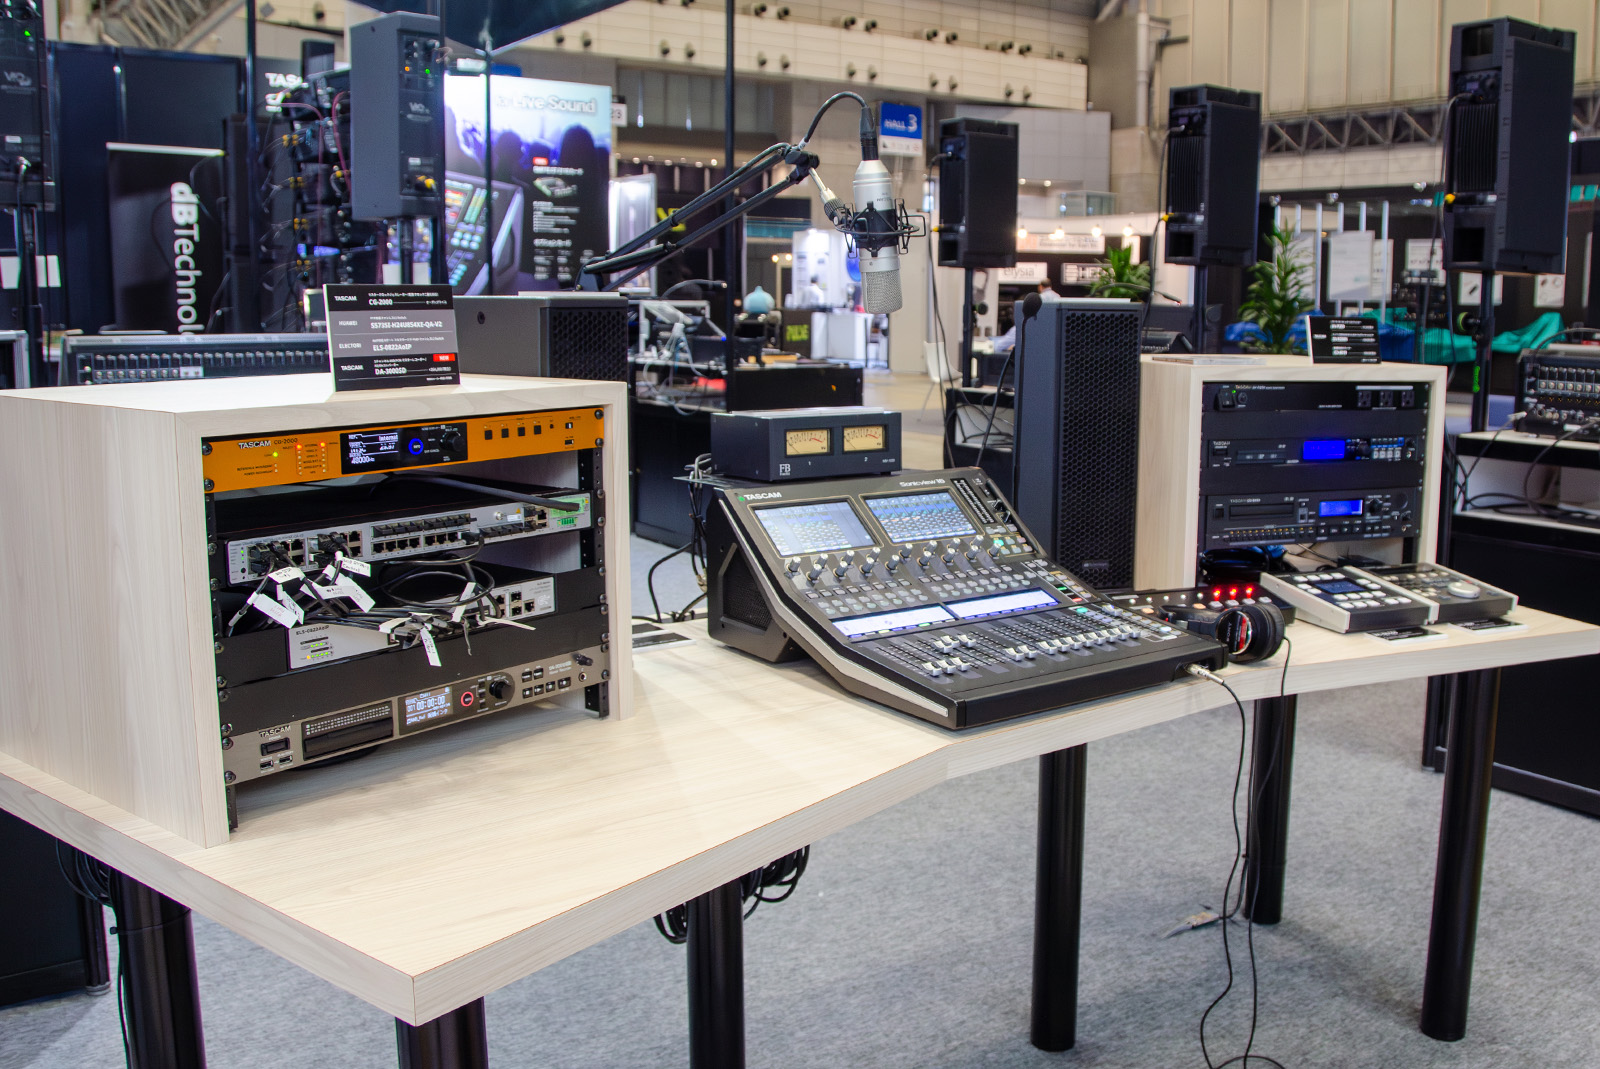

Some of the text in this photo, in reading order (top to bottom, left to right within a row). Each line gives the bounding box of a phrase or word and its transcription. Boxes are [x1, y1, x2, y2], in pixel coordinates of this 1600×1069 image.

[548, 95, 597, 114] Sound
[907, 113, 917, 132] 3
[170, 181, 205, 335] dBTechnol
[368, 298, 393, 306] CG-2000
[238, 440, 271, 449] TASCAM
[744, 492, 782, 501] TASCAM
[260, 725, 291, 737] TASCAM
